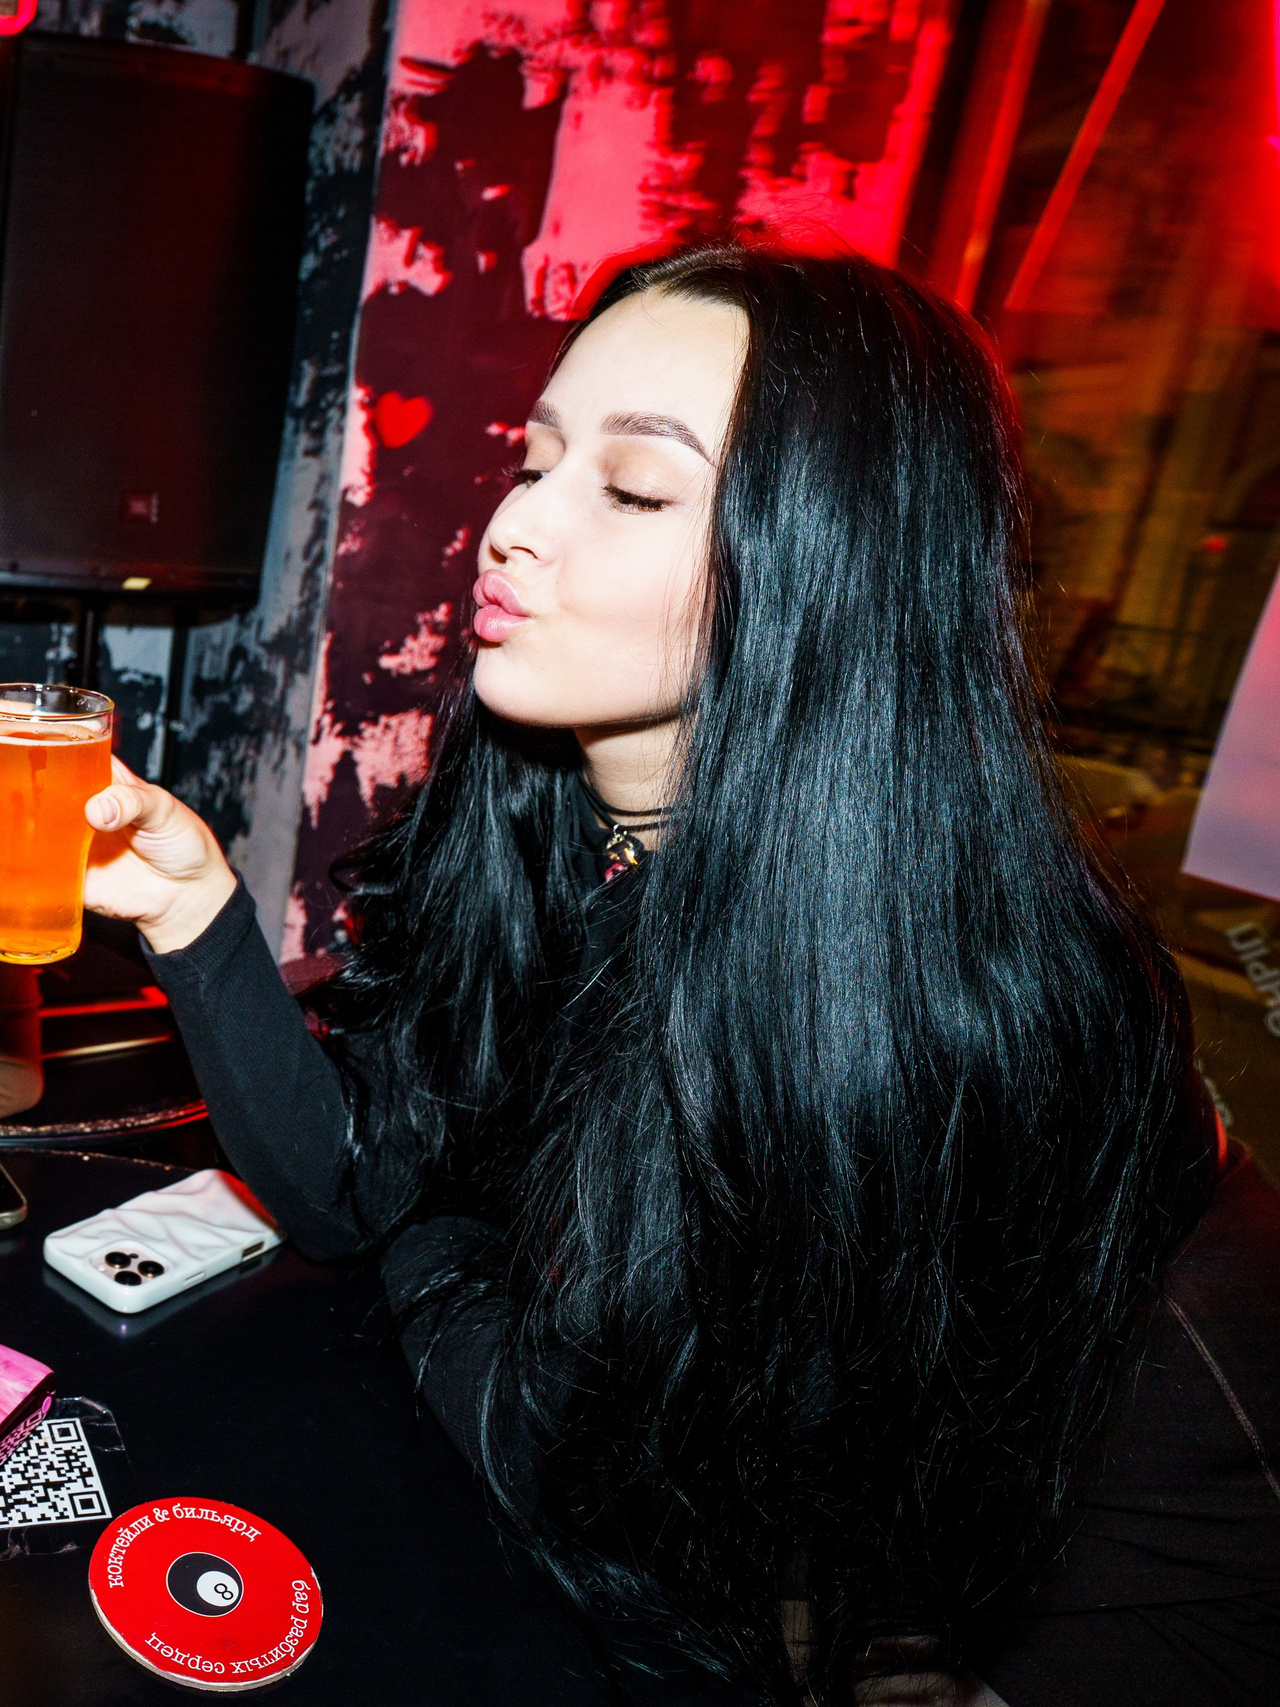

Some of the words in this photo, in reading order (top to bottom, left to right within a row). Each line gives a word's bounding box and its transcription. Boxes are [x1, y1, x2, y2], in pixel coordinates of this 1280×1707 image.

[107, 1514, 154, 1589] коктейли
[152, 1507, 170, 1523] &
[172, 1503, 261, 1543] бильярд
[213, 1582, 234, 1600] 8
[291, 1579, 311, 1614] бар
[144, 1632, 226, 1674] сердец
[230, 1615, 307, 1674] разбитых
